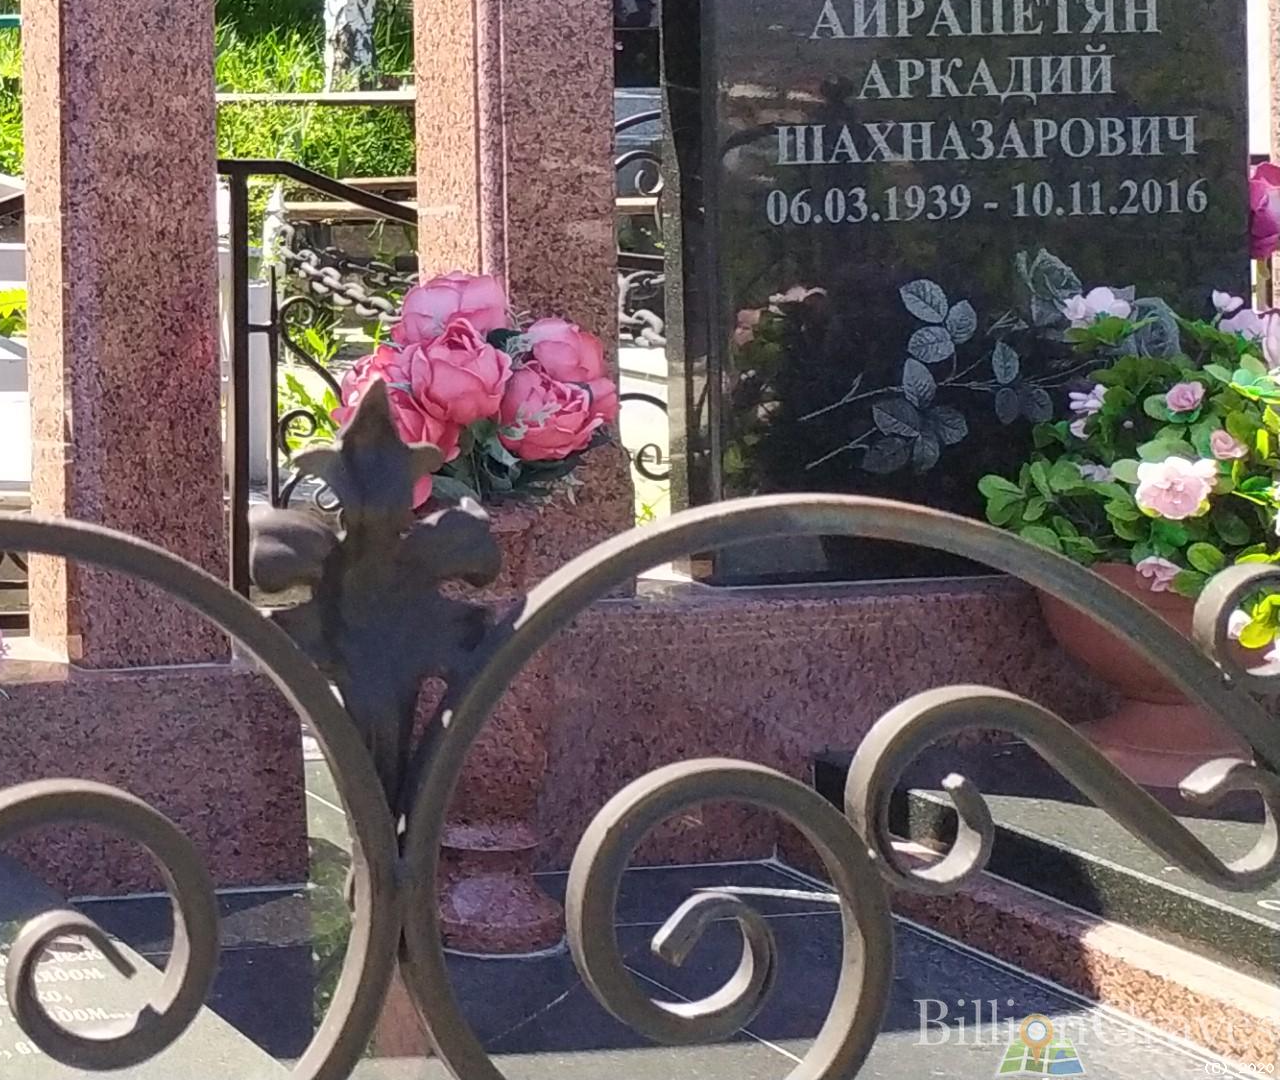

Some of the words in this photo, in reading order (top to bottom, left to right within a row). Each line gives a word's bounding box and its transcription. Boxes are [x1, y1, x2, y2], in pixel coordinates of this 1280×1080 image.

[857, 43, 1116, 105] АРКАДИЙ
[775, 116, 1199, 166] ШАХНАЗАРОВИЧ
[766, 184, 971, 226] 06.03.1939
[1011, 178, 1208, 219] 10.11.2016
